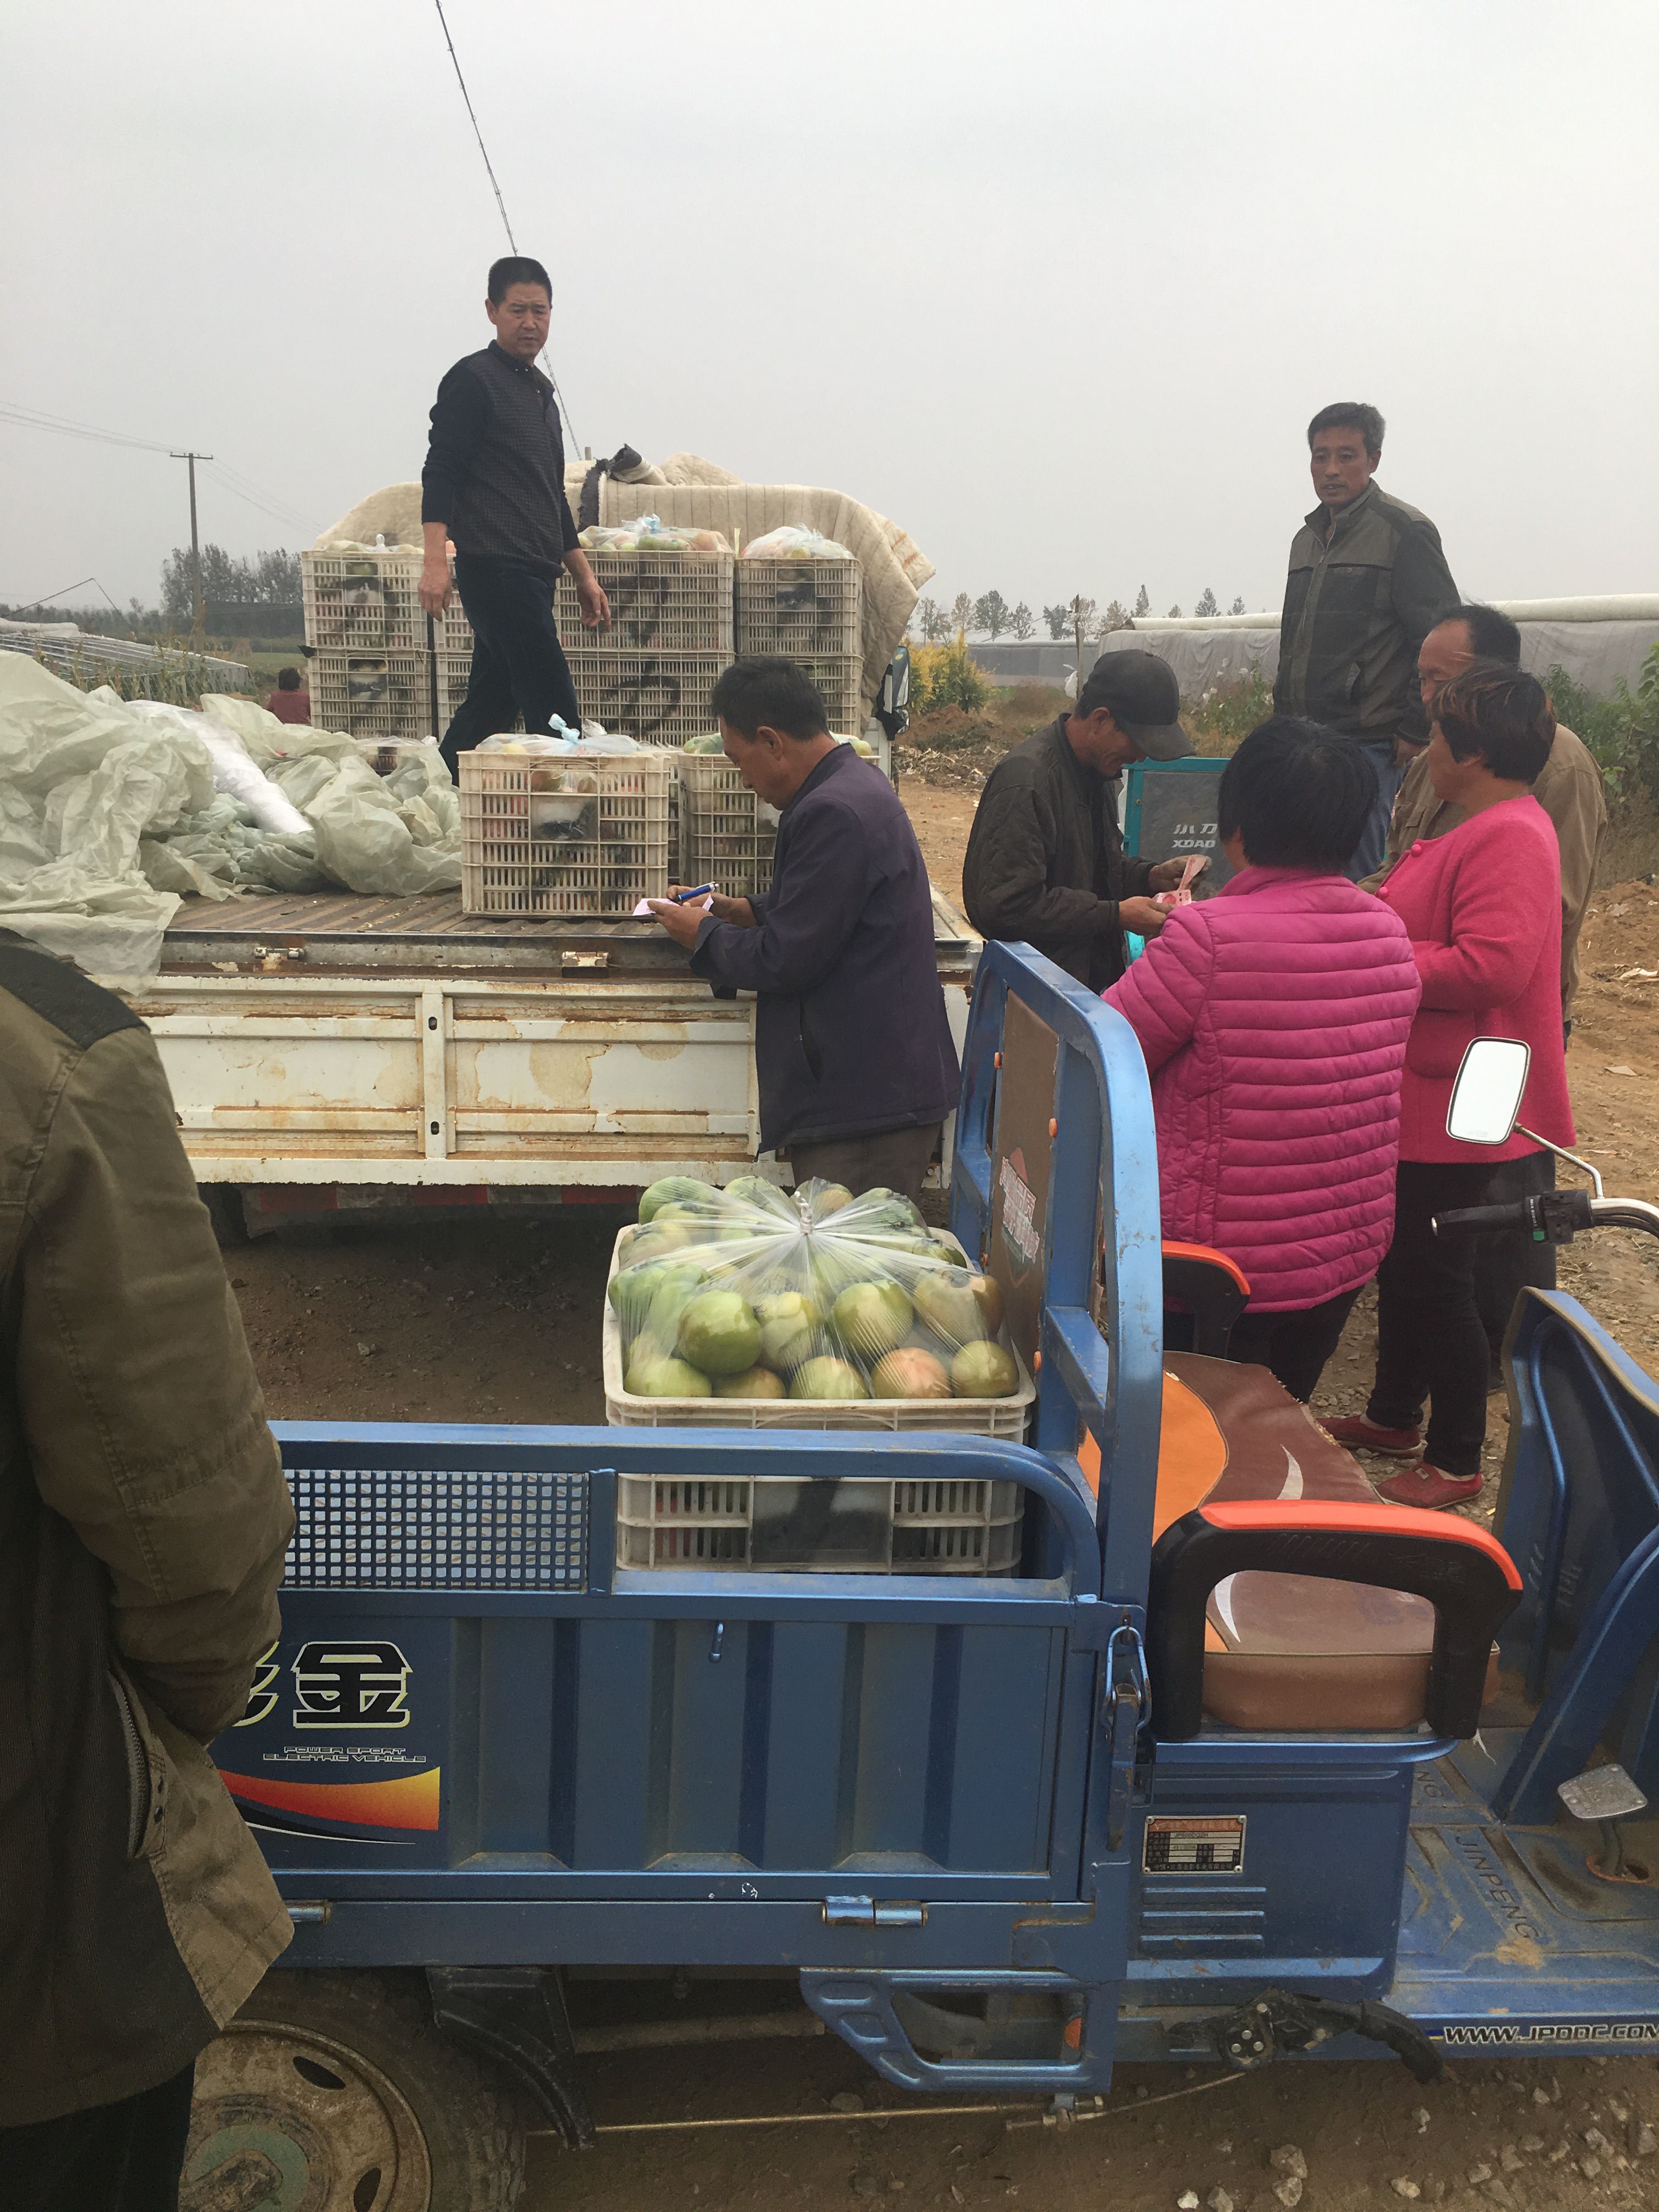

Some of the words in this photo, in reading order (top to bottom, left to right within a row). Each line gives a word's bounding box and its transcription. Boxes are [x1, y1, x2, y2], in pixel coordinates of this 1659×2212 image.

[1173, 823, 1218, 834] 小刀
[263, 1753, 349, 1762] ELECTRIC
[352, 1754, 427, 1763] VEHICLE
[1455, 1836, 1540, 1938] JINPENG
